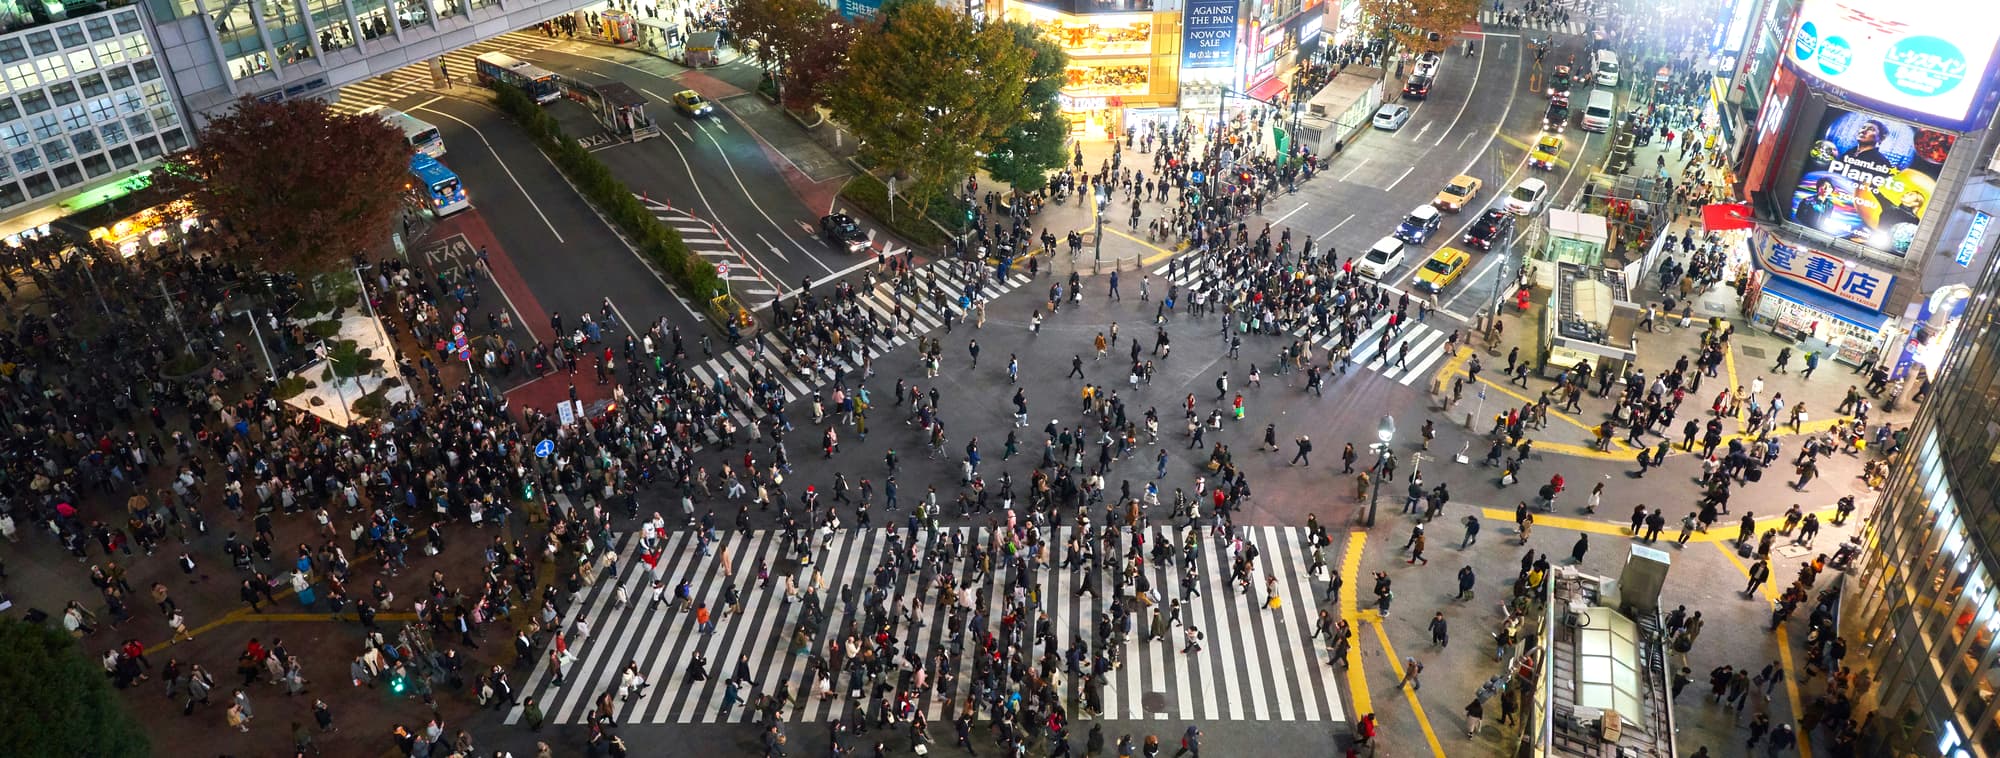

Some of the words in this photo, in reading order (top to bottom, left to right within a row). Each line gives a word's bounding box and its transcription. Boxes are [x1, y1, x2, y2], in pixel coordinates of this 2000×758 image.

[1193, 6, 1233, 15] AGAINST
[1191, 16, 1210, 24] THE
[1212, 16, 1234, 24] PAIN
[1190, 31, 1215, 39] NOW
[1200, 39, 1220, 47] SALE
[1843, 155, 1889, 174] teamLab
[1828, 160, 1905, 192] Planets
